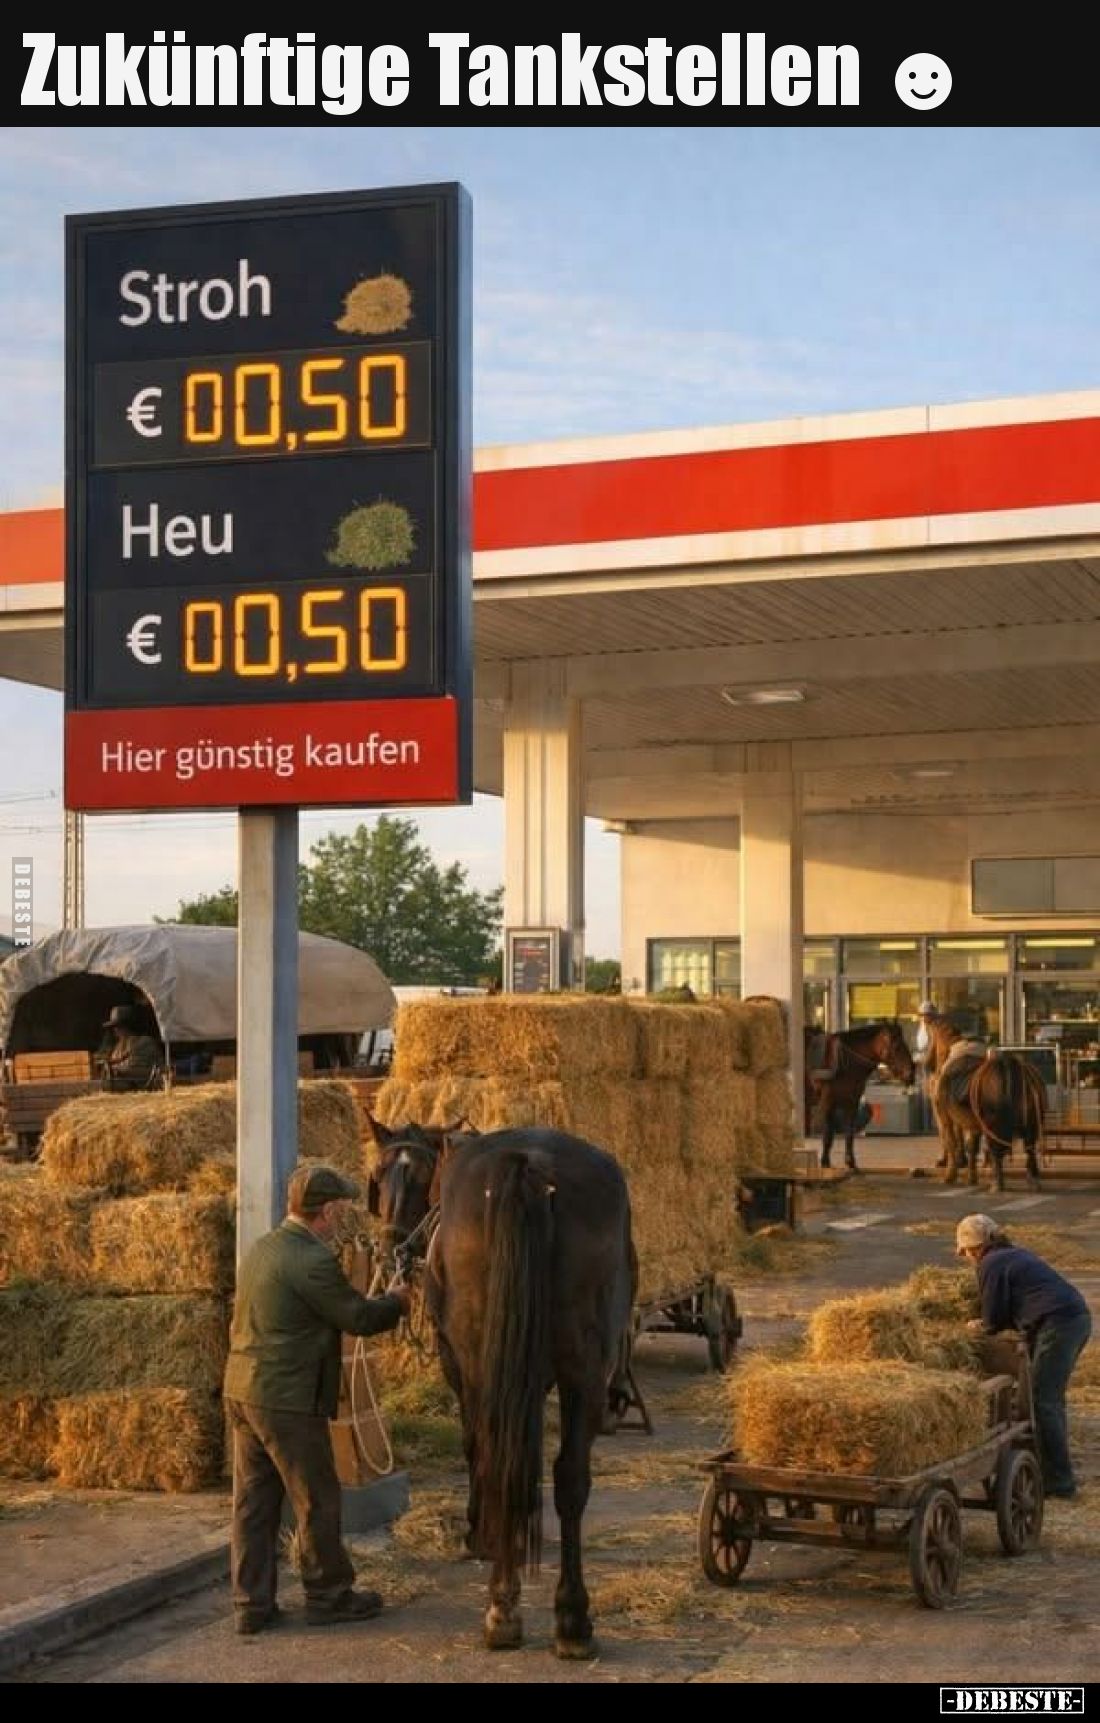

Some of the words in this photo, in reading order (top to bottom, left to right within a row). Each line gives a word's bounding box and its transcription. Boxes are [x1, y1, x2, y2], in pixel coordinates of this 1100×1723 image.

[119, 258, 271, 327] Stroh
[126, 386, 162, 438] €
[185, 354, 406, 451] 00,50
[121, 502, 234, 559] Heu
[126, 614, 162, 665] €
[184, 586, 407, 683] 00,50
[101, 740, 166, 772] Hier
[175, 737, 294, 779] günstig
[305, 732, 420, 767] kaufen
